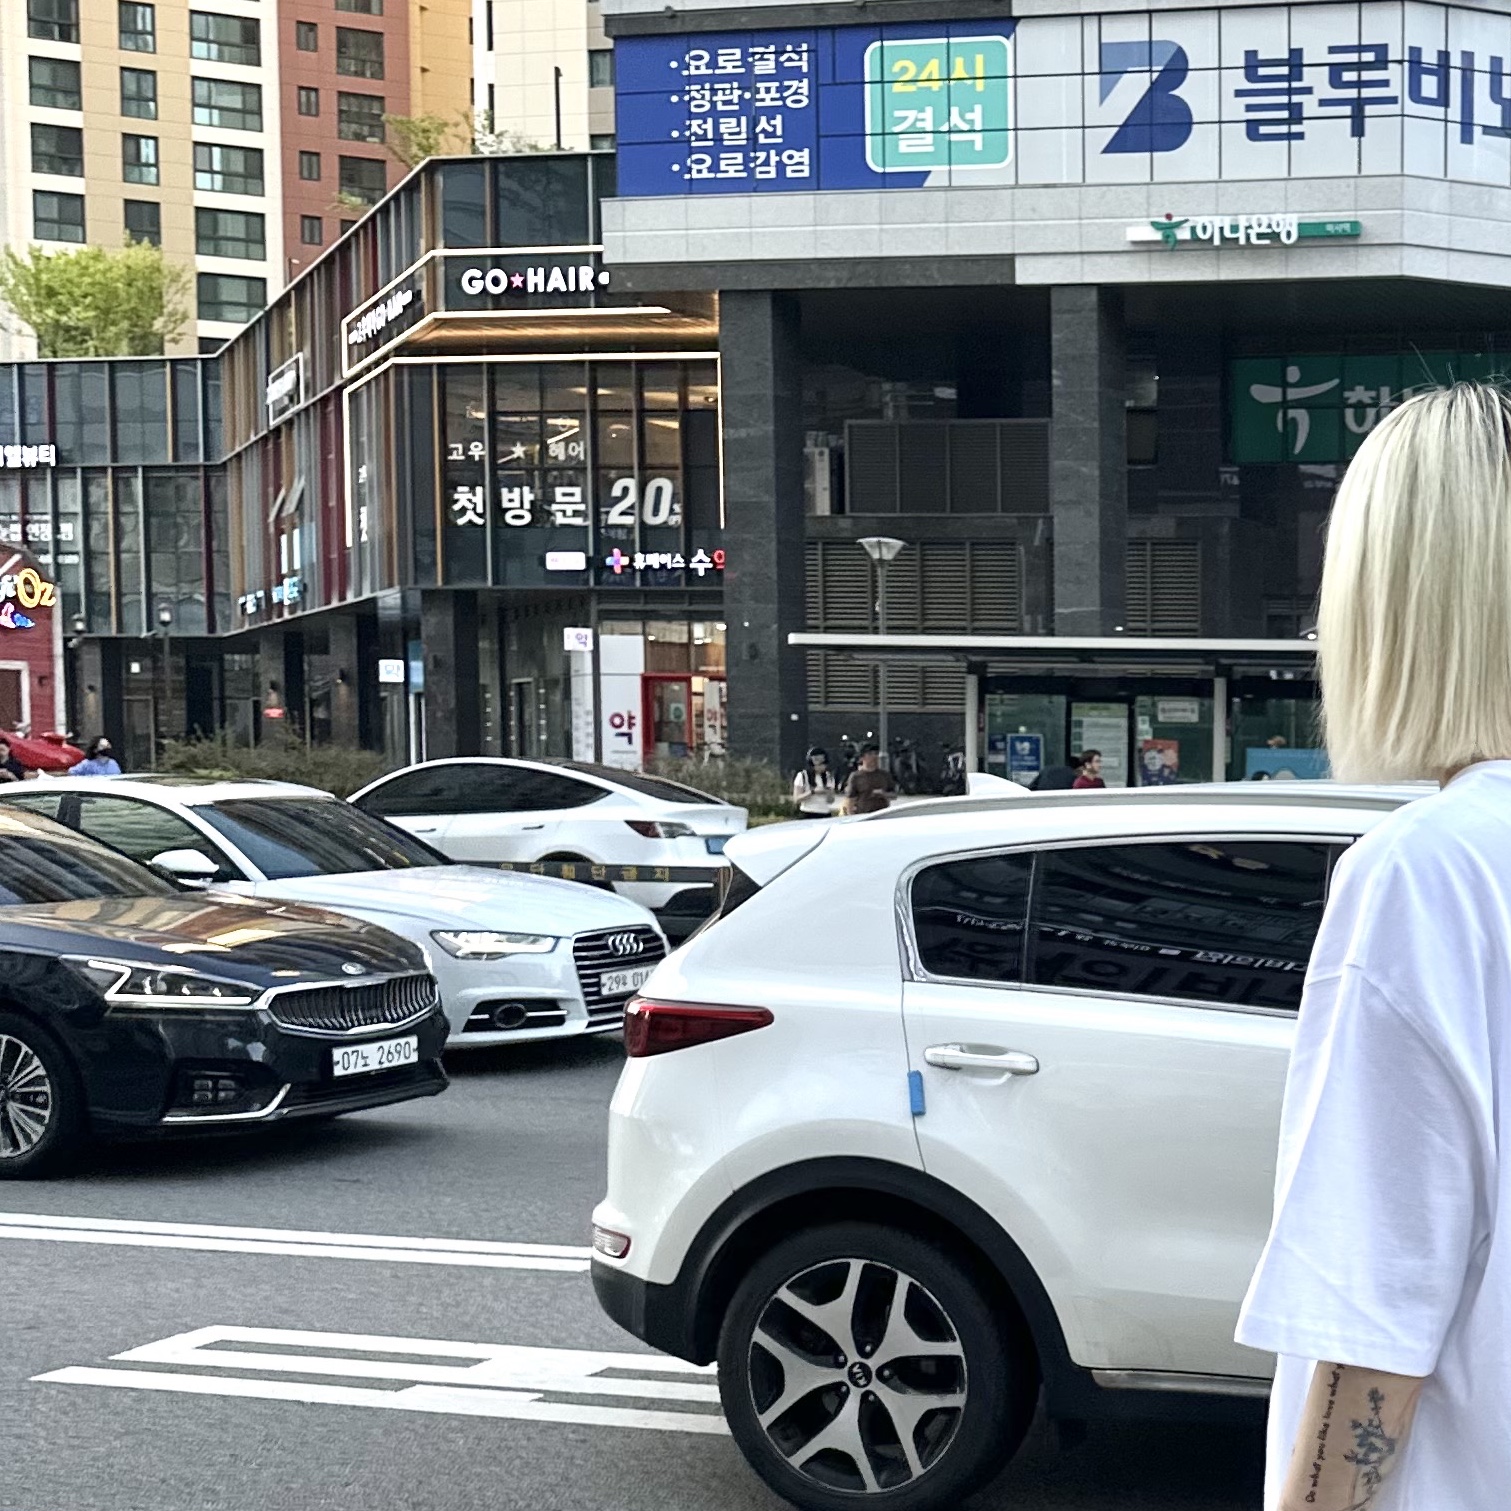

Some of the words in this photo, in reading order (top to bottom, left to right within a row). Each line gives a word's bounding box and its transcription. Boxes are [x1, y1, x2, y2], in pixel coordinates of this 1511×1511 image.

[685, 43, 809, 77] 요로결석
[892, 54, 986, 94] 24시
[687, 114, 784, 146] 전립선
[891, 105, 985, 154] 결석
[685, 148, 811, 180] 요로감염
[462, 266, 509, 296] GO
[527, 266, 596, 293] HAIR
[448, 441, 486, 461] 고우
[548, 441, 585, 461] 헤어
[609, 709, 637, 746] 약
[341, 1049, 371, 1072] 07노
[376, 1040, 412, 1066] 2690
